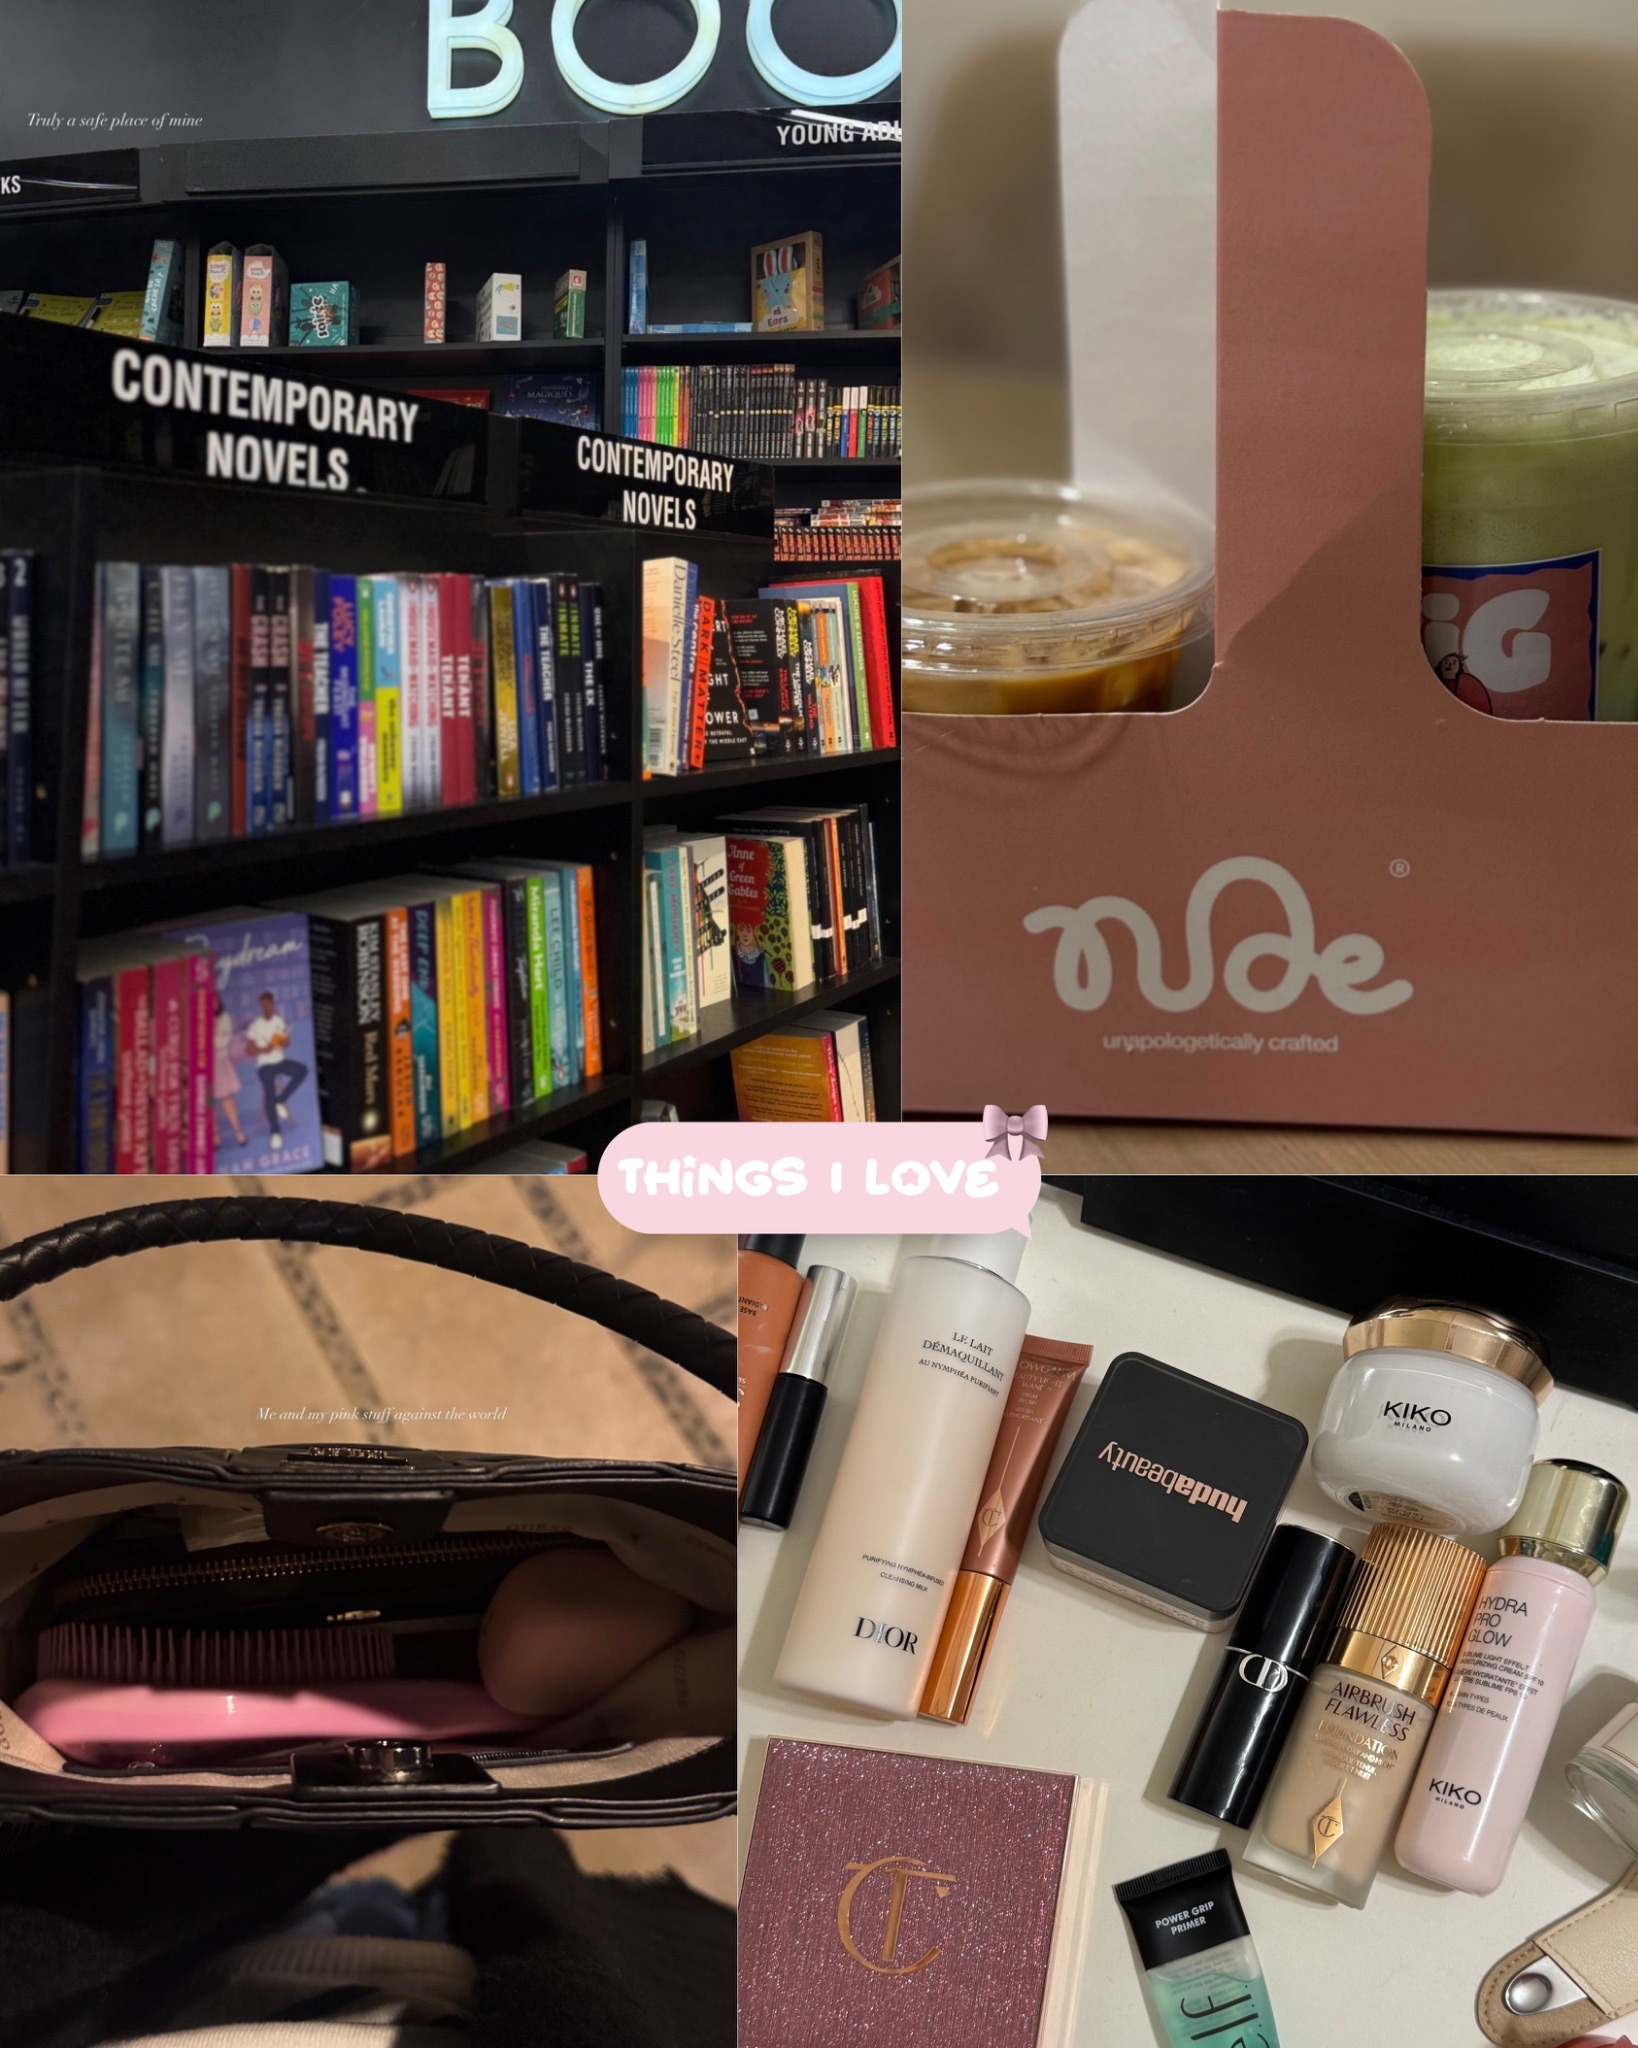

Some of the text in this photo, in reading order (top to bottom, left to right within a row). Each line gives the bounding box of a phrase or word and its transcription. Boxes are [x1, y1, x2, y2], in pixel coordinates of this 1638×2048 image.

[777, 122, 854, 146] YOUNG
[110, 347, 419, 443] CONTEMPORARY
[527, 390, 573, 399] MAGIQUES
[206, 430, 349, 492] NOVELS
[576, 434, 735, 494] CONTEMPORARY
[622, 489, 696, 531] NOVELS
[332, 596, 344, 653] FOLEY
[343, 599, 354, 646] LUCY
[559, 609, 569, 657] INMATE
[570, 609, 580, 657] INMATE
[593, 607, 604, 659] ONE ONE
[670, 563, 687, 682] Danielle Steel
[773, 607, 784, 660] CONNELLY
[778, 610, 787, 656] MICHAEL
[786, 606, 796, 659] CONNELLY
[791, 609, 800, 655] MICHAEL
[538, 625, 552, 702] THE TEACHER
[802, 639, 811, 685] CONNELLY
[806, 641, 815, 682] MICHAEL
[855, 632, 864, 670] LEGENDS
[314, 652, 330, 714] TEACHER
[441, 654, 455, 719] TENANT
[457, 654, 471, 719] TENANT
[584, 660, 595, 706] THE EX
[694, 600, 712, 752] DARK MATTER
[728, 844, 755, 860] Anne
[738, 862, 745, 872] of
[728, 885, 759, 899] Gables
[729, 870, 755, 885] Green
[529, 885, 544, 990] Miranda Hart
[550, 907, 560, 931] LEE
[1023, 856, 1414, 1016] nude
[391, 930, 399, 951] THE
[399, 921, 409, 1001] THE LAST ONE
[355, 924, 372, 1025] ROBINSON
[368, 921, 381, 1022] KIM STANLEY
[391, 953, 402, 1014] WEDDING
[551, 937, 563, 990] CHILD
[1103, 1032, 1338, 1053] unapologetically crafted
[364, 1030, 380, 1104] Red Mars
[259, 1145, 312, 1167] GRACE
[922, 1339, 1005, 1382] DÉMAQUILLANT
[953, 1332, 994, 1357] LE LAIT
[918, 1358, 999, 1398] AU NYMPHÉA PURIFIANT
[1383, 1400, 1452, 1427] KIKO
[1393, 1420, 1432, 1433] MILANO
[1098, 1440, 1249, 1524] hudabeauty
[862, 1554, 945, 1587] PURIFYING NYMPHÉA-INFUSED
[915, 1583, 929, 1593] MILK
[1472, 1612, 1502, 1628] PRO
[1477, 1596, 1528, 1617] HYDRA
[853, 1616, 919, 1656] DIOR
[1467, 1628, 1512, 1648] GLOW
[1484, 1654, 1530, 1671] LIGHT EFFECT
[1498, 1664, 1524, 1678] CREAM
[1331, 1681, 1416, 1726] AIRBRUSH
[1469, 1693, 1490, 1704] TYPES
[1476, 1678, 1518, 1698] SUBLIME FPS
[1324, 1697, 1410, 1743] FLAWLESS
[1458, 1702, 1509, 1723] TYPES DE PEAUX
[1318, 1719, 1401, 1762] FOUNDATION
[1346, 1745, 1362, 1756] DAY
[1360, 1751, 1376, 1763] AND
[1346, 1765, 1372, 1781] ET NUIT
[1428, 1777, 1482, 1806] KIKO
[1434, 1796, 1465, 1810] MILANO
[1154, 1900, 1216, 1930] POWER GRIP
[1170, 1916, 1207, 1936] PRIMER
